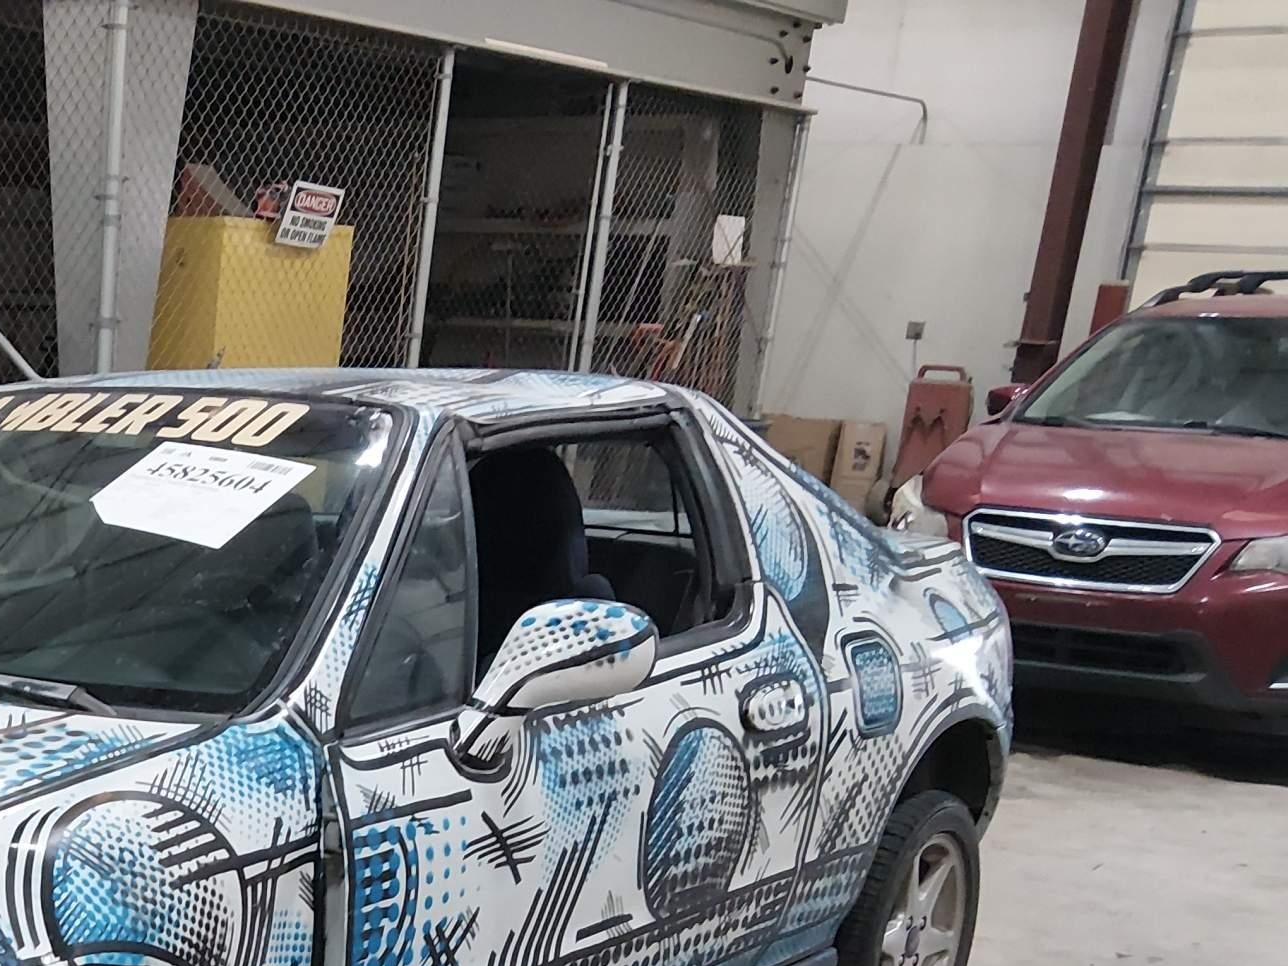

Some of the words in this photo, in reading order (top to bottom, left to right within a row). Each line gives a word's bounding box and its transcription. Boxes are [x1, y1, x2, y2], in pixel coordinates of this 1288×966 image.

[297, 193, 334, 211] DANGER
[289, 215, 300, 227] NO
[300, 217, 328, 231] SMOKING
[279, 227, 290, 239] OR
[289, 229, 307, 241] OPEN
[155, 396, 311, 447] 500
[147, 461, 272, 494] 45825604
